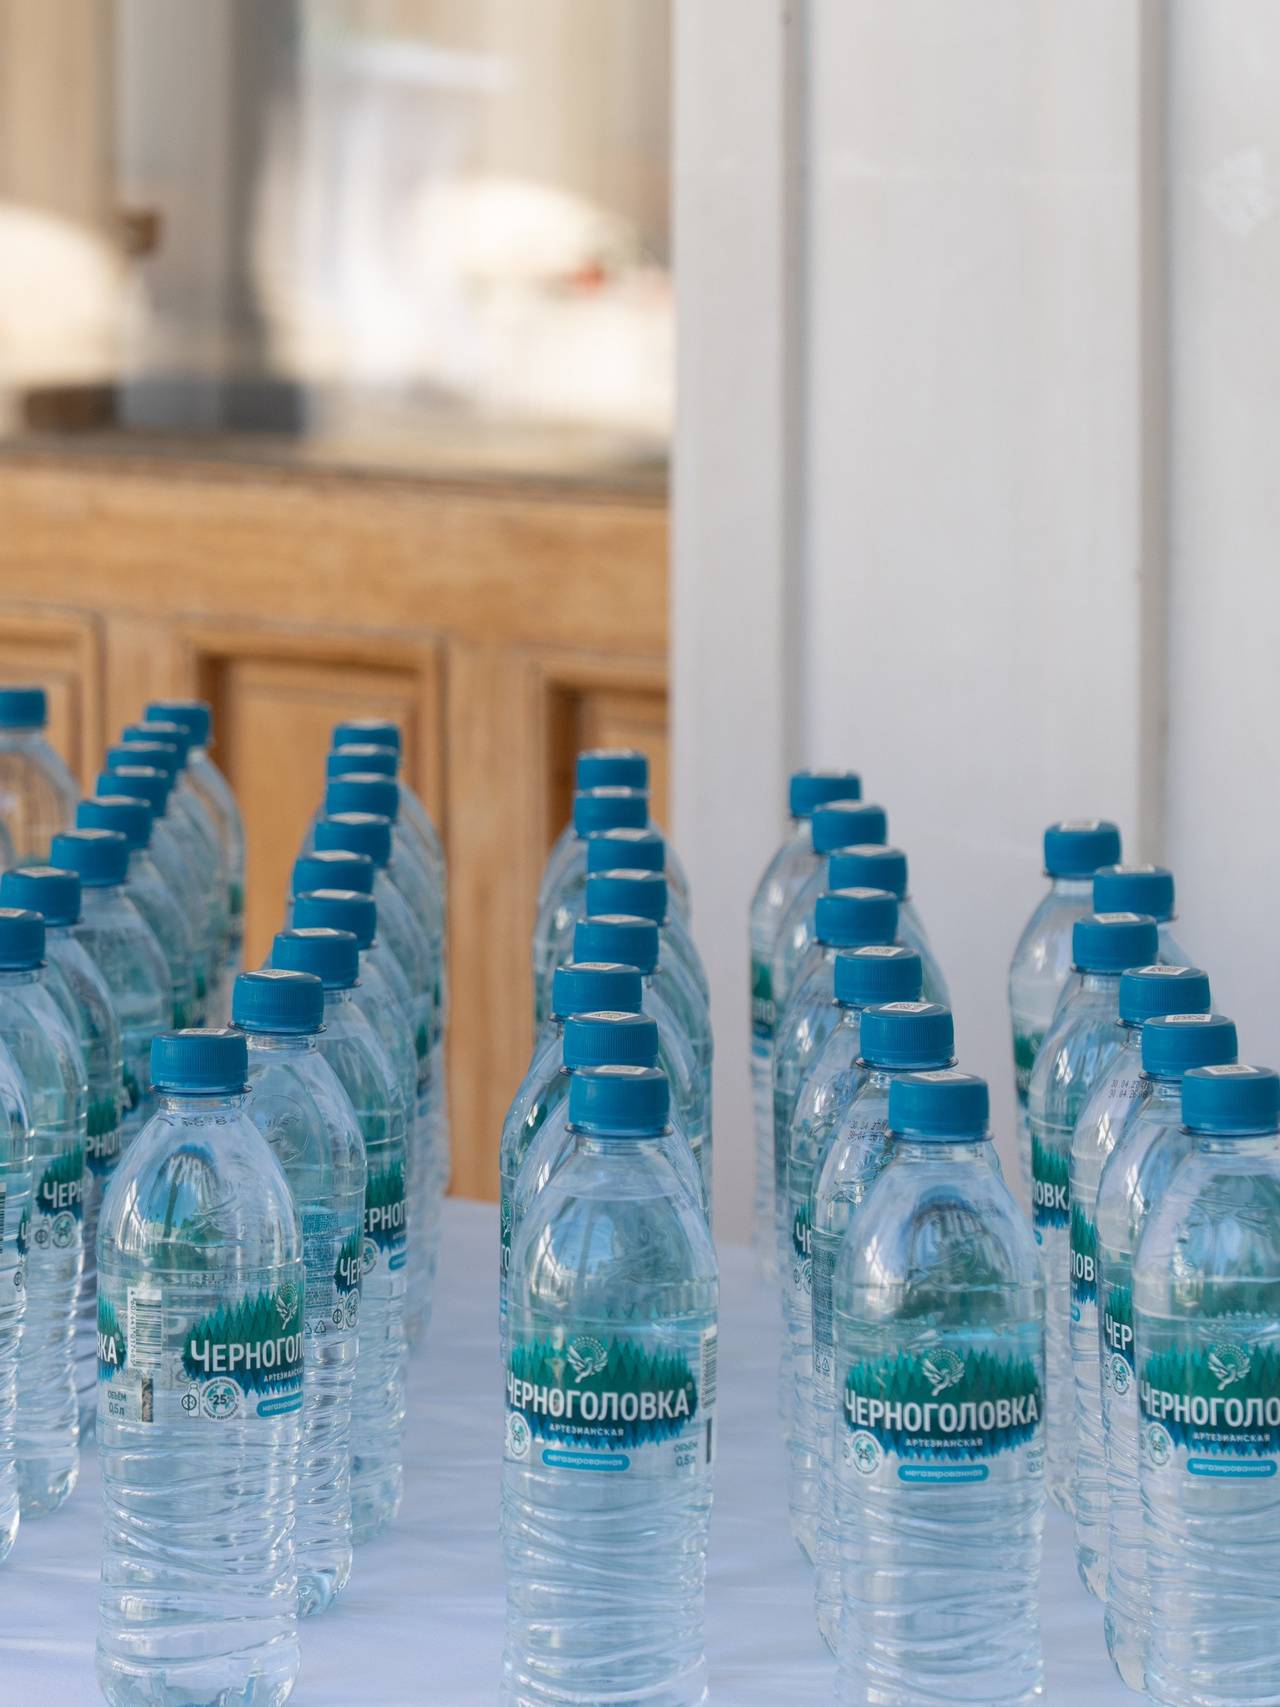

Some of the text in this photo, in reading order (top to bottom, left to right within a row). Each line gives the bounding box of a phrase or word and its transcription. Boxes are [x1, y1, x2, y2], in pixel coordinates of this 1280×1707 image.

[191, 1330, 304, 1372] ЧЕРНОГОЛ
[506, 1370, 689, 1421] ЧЕРНОГОЛОВКА
[845, 1389, 1039, 1433] ЧЕРНОГОЛОВКА
[549, 1423, 624, 1437] АРТЕЗИАНСКАЯ
[905, 1438, 983, 1448] АРТЕЗИАНСКАЯ
[1193, 1432, 1271, 1443] АРТЕЗИАНСКАЯ
